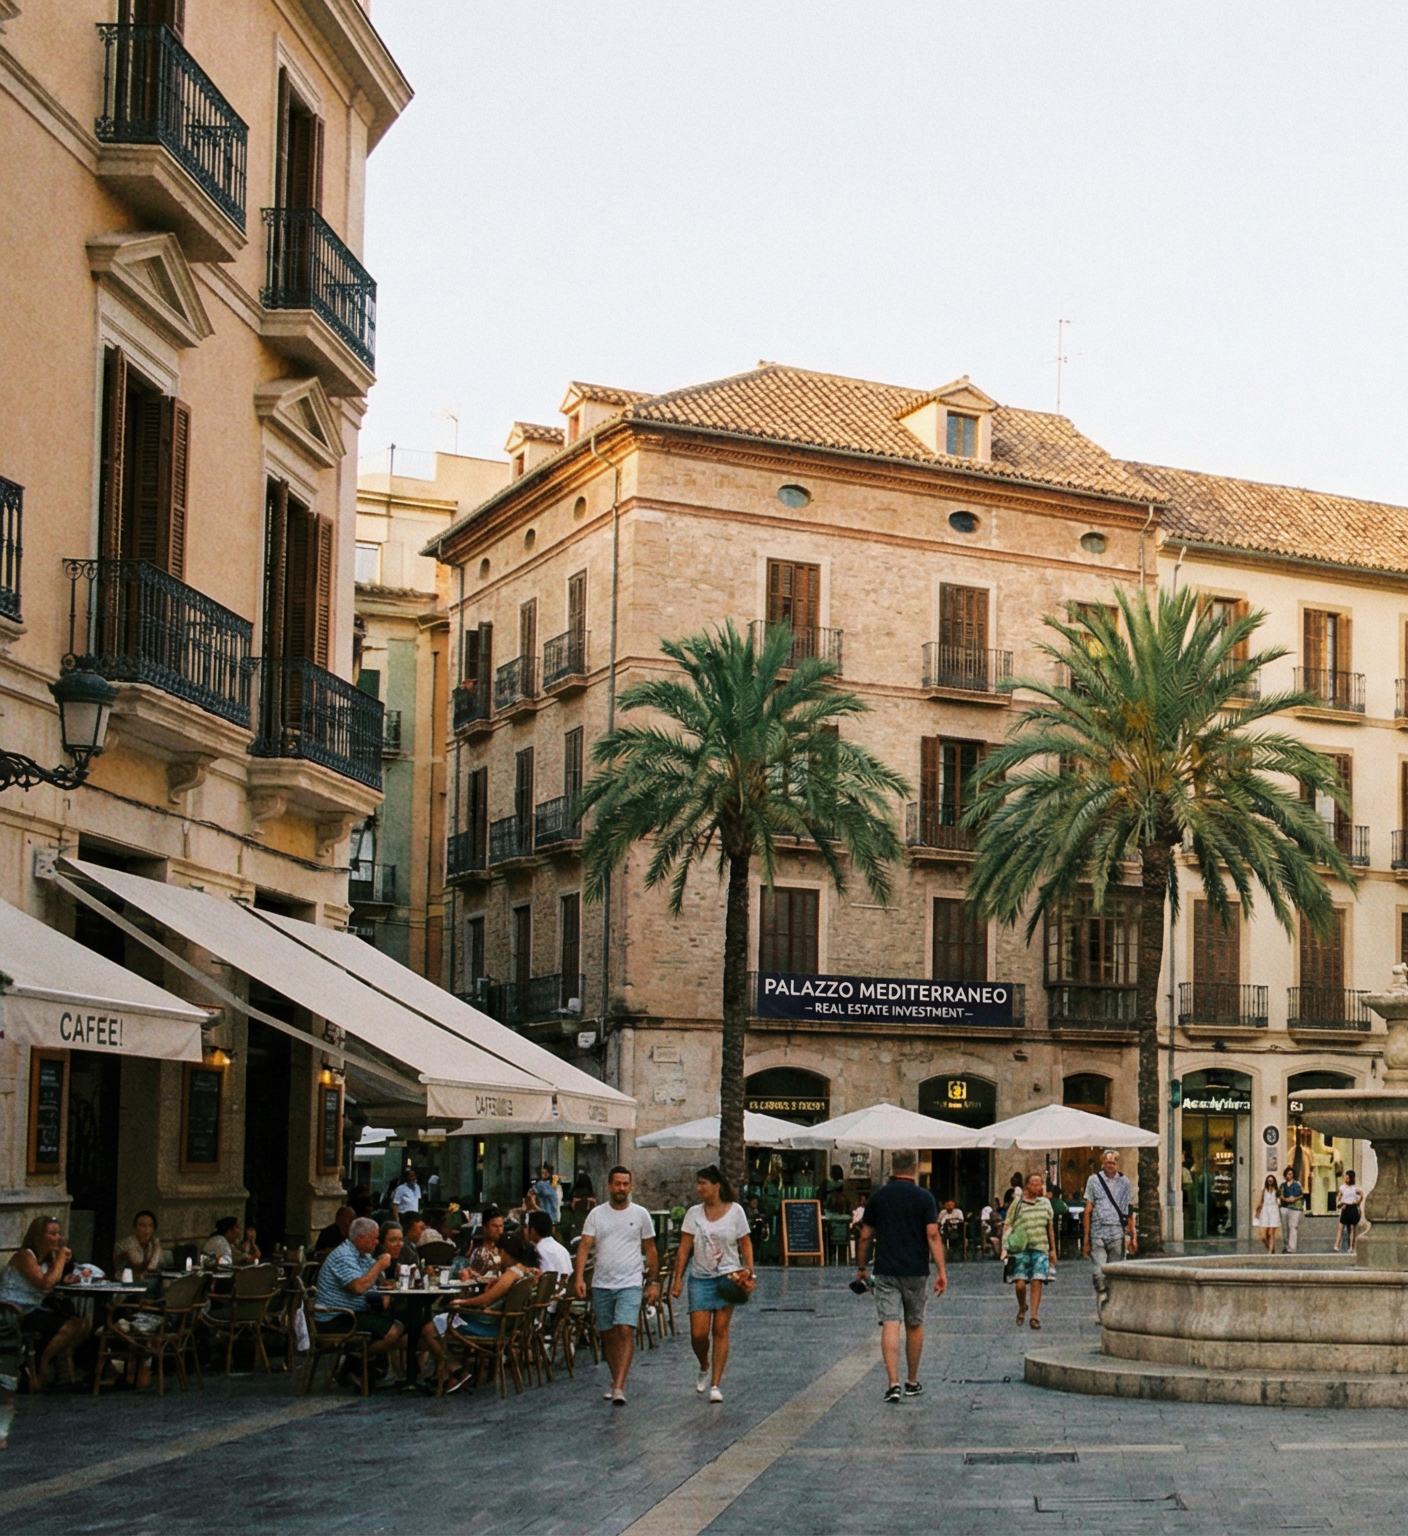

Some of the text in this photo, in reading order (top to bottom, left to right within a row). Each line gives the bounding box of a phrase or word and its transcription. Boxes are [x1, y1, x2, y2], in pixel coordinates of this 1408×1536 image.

[764, 978, 1007, 1004] PALAZZO MEDITERRANEO
[815, 1003, 965, 1018] REAL ESTATE INVESTMENT
[60, 1012, 123, 1046] CAFEE!
